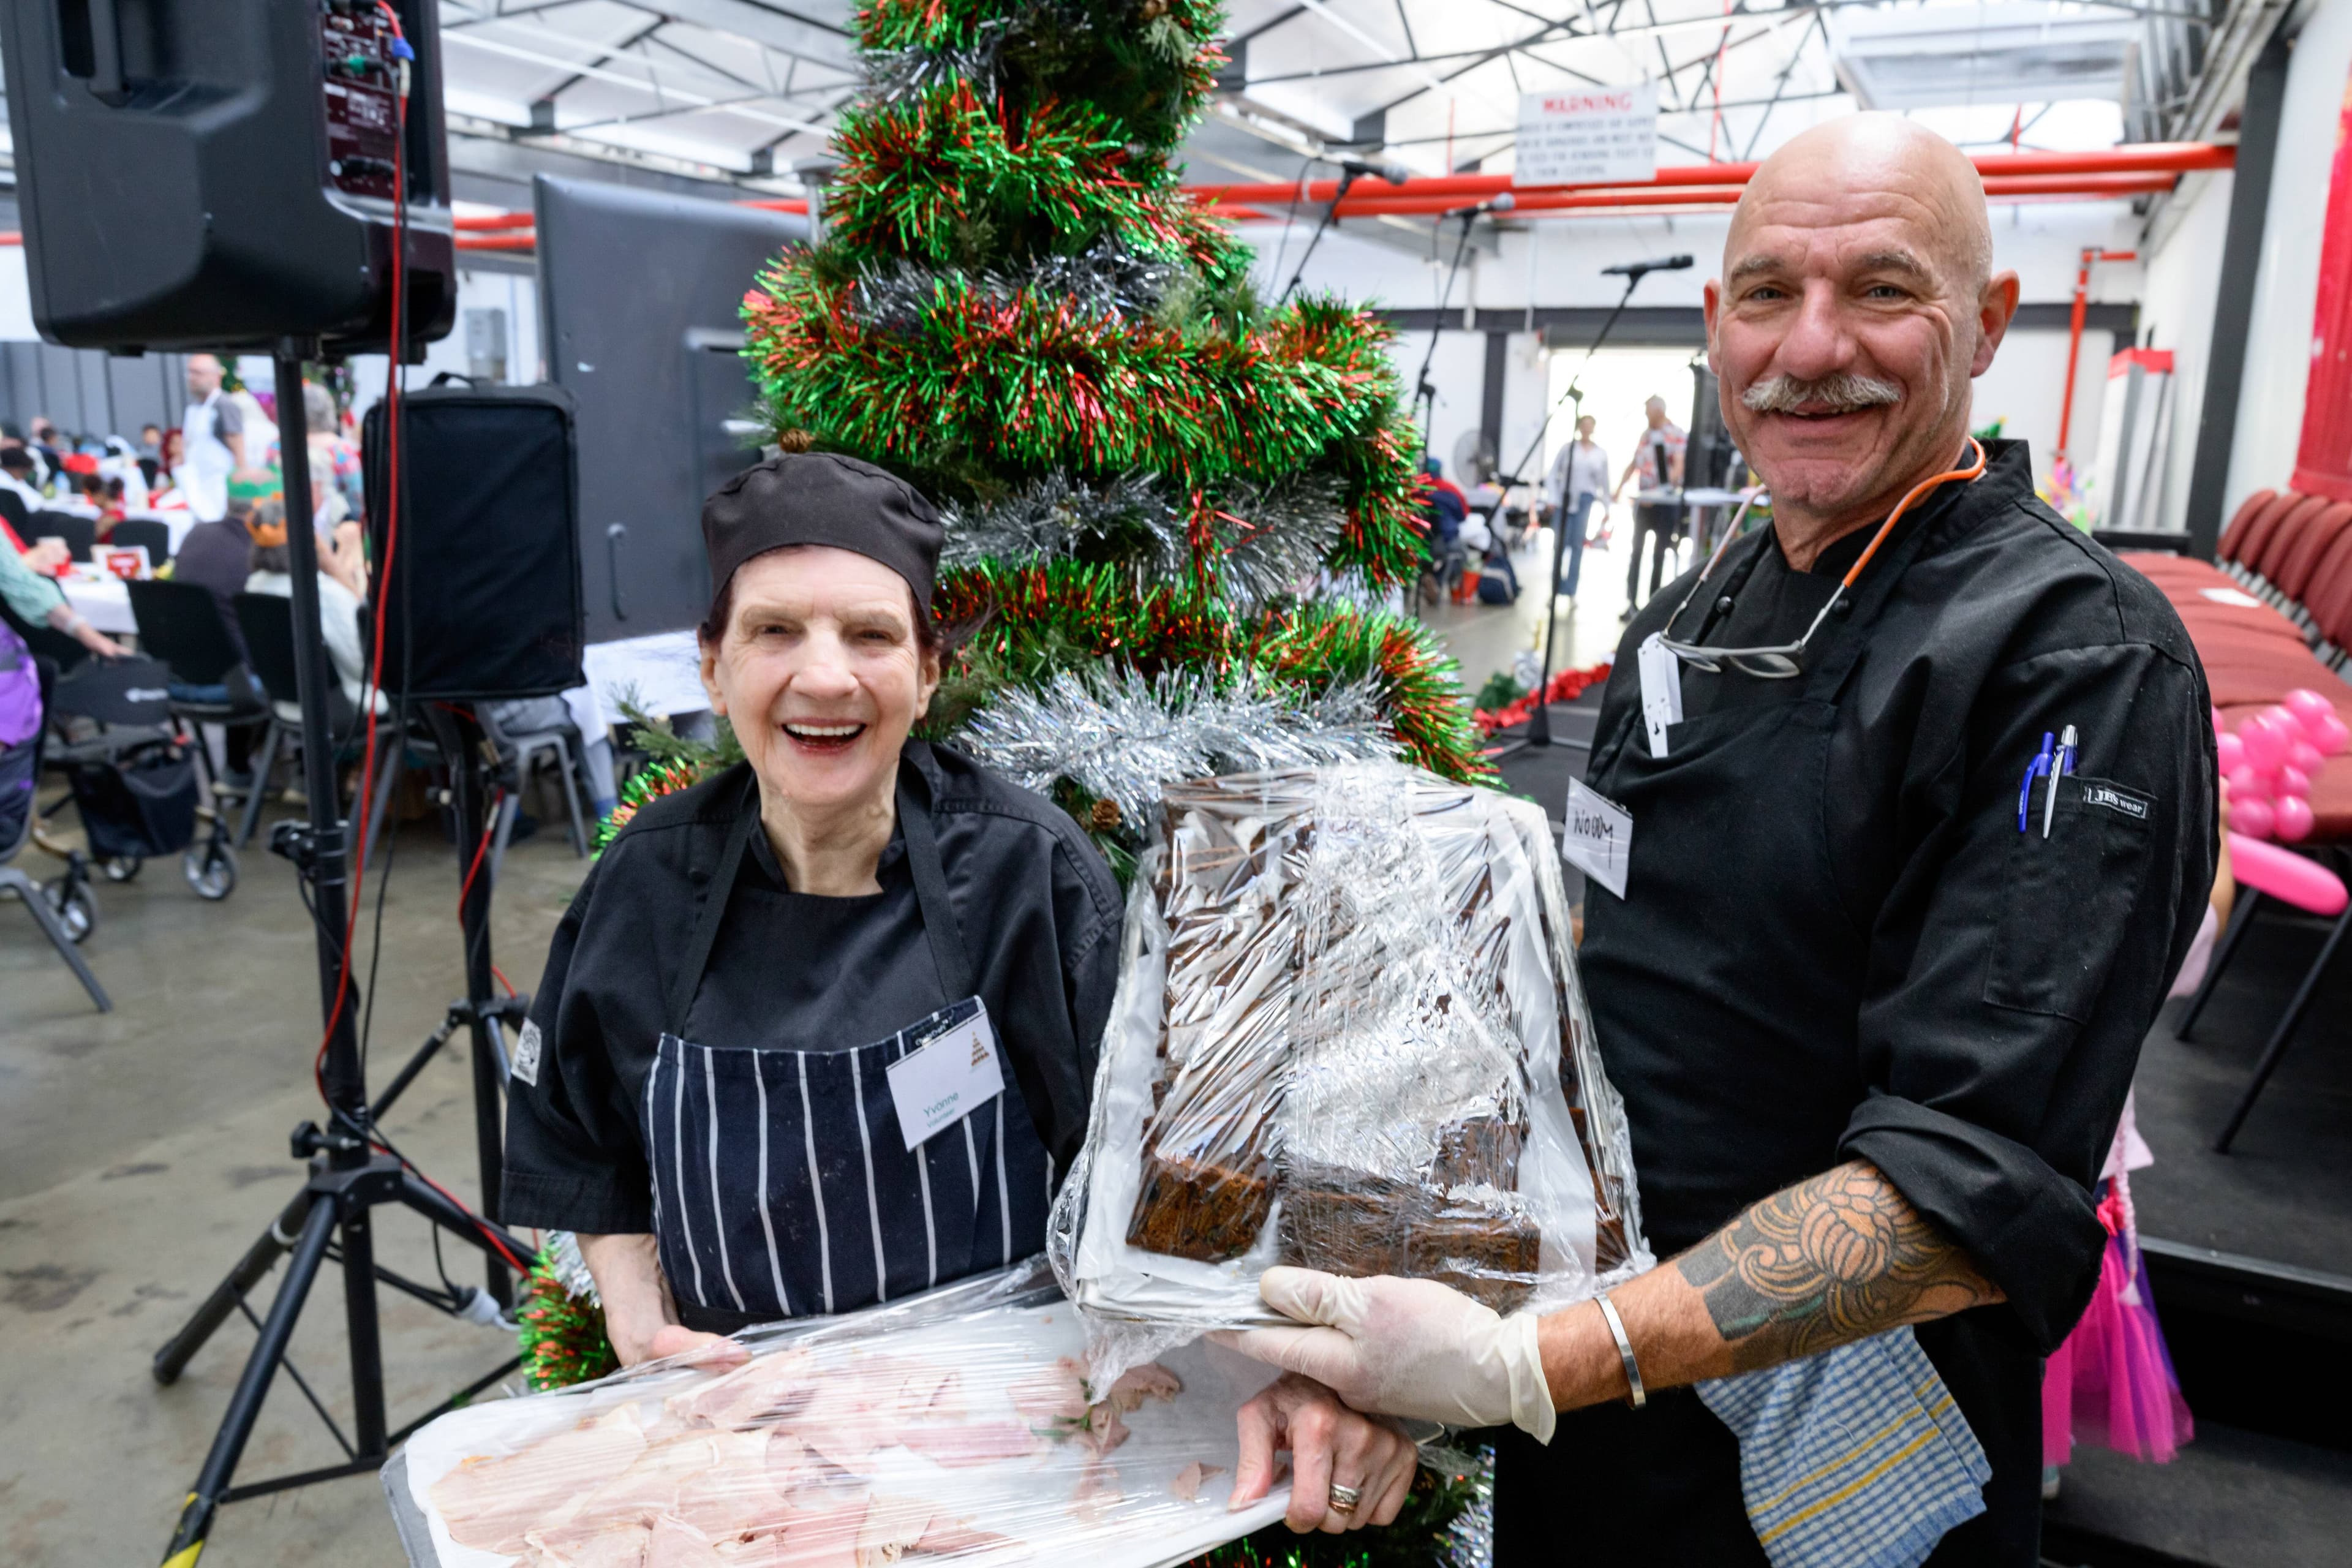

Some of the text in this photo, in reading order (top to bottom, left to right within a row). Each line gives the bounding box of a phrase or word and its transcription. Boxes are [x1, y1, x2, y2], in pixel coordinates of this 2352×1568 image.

[2095, 790, 2143, 814] JB's wear
[922, 1092, 959, 1118] Yvonne
